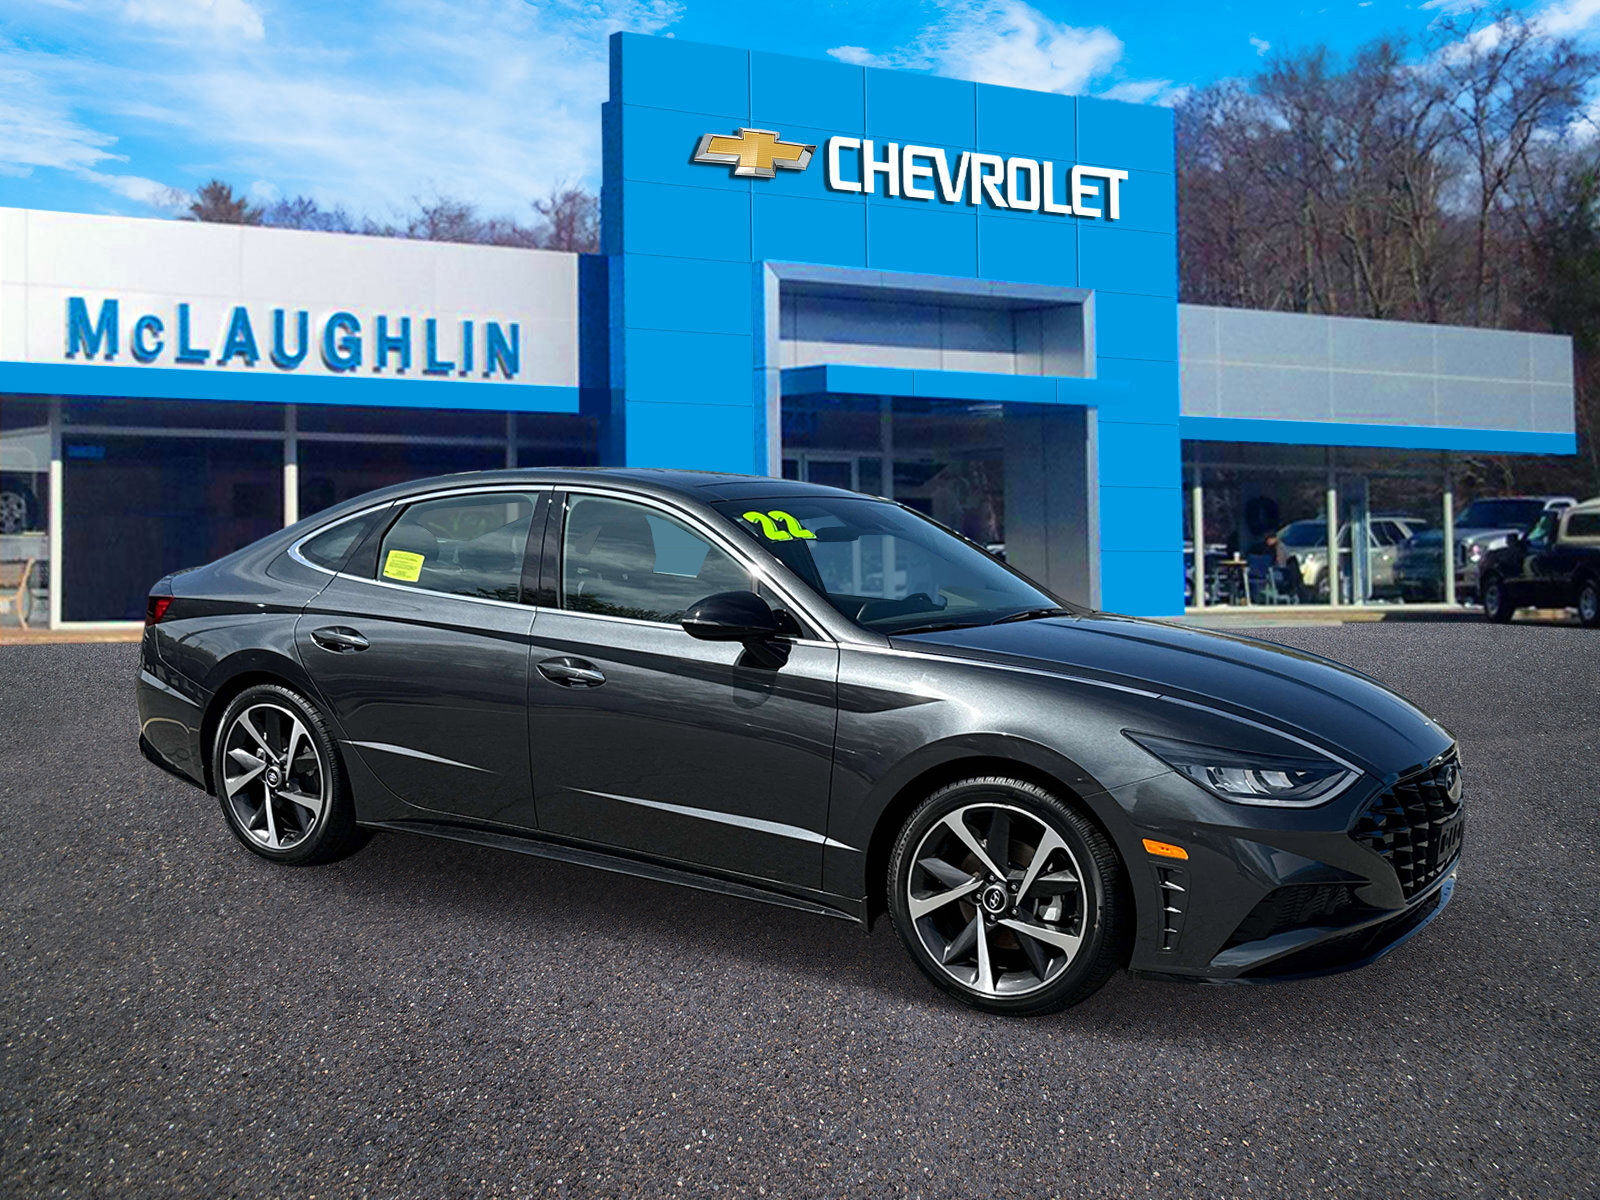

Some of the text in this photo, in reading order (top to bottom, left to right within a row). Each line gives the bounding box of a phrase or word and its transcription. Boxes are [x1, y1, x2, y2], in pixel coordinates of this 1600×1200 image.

[828, 135, 1129, 220] CHEVROLET
[65, 296, 520, 379] McLAUGHLIN
[742, 510, 817, 541] 22
